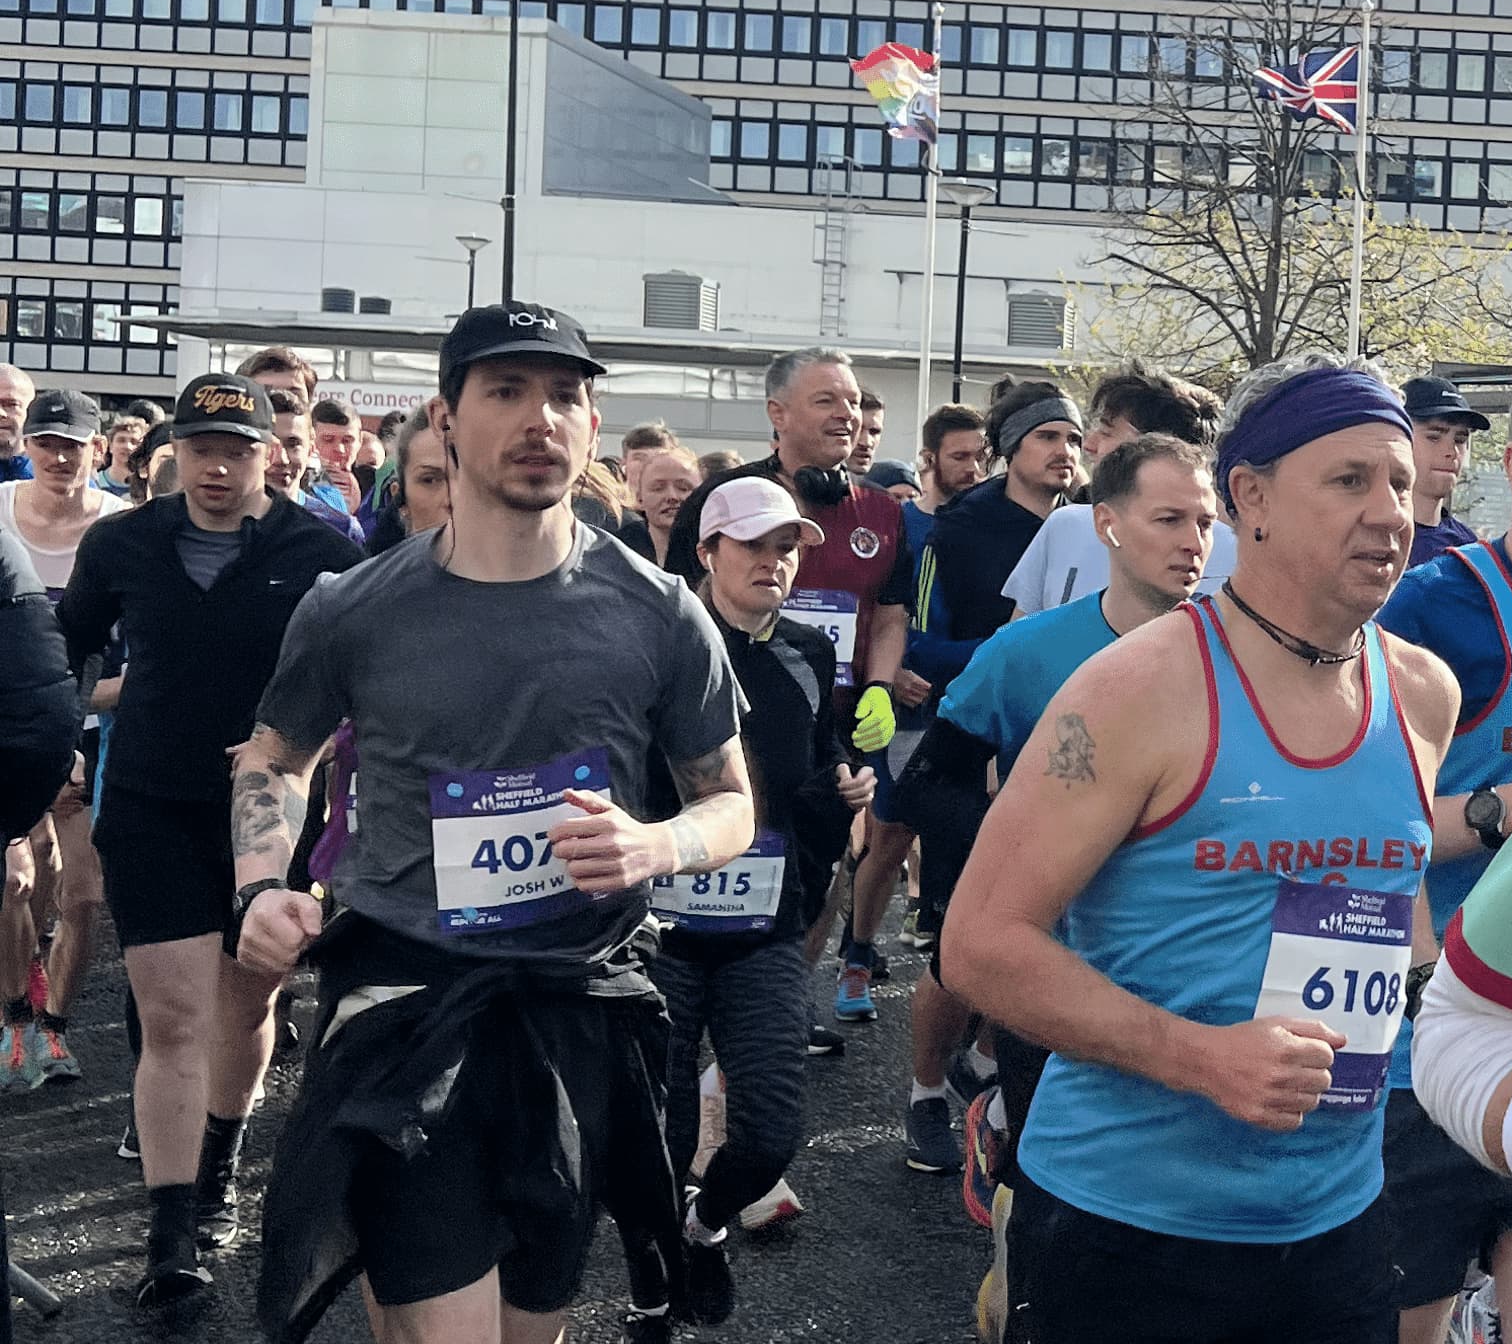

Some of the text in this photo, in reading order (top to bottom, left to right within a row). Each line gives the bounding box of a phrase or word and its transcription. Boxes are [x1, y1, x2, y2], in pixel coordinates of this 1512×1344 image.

[194, 385, 256, 414] Tigers
[471, 831, 553, 875] 407
[1194, 837, 1428, 873] BARNSLEY
[505, 881, 545, 897] JOSH
[691, 871, 752, 896] 815
[1343, 924, 1367, 935] HALF
[1345, 912, 1387, 926] SHEFFIELD
[1302, 966, 1401, 1016] 6108
